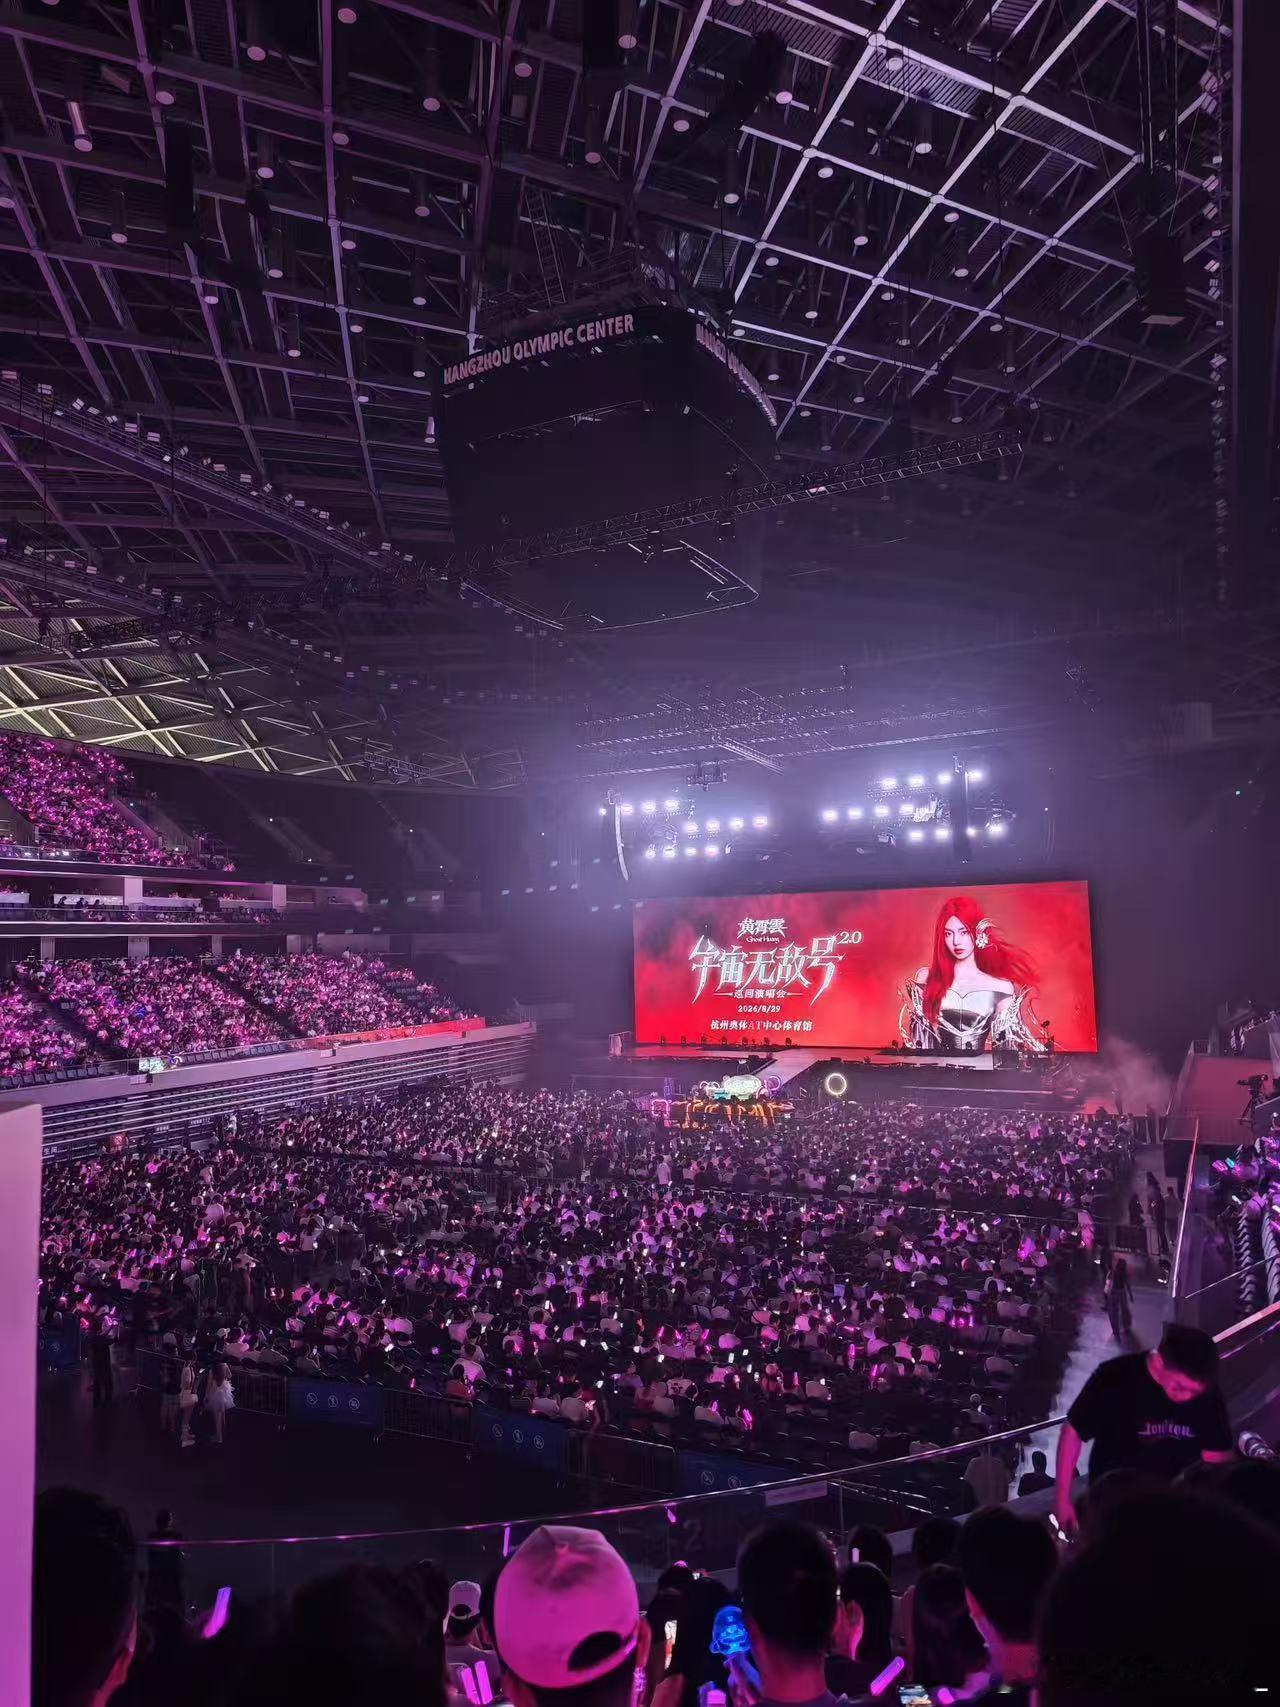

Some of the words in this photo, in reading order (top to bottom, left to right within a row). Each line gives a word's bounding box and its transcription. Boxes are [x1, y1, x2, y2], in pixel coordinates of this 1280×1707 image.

[443, 345, 511, 385] HANGZHOU
[513, 327, 574, 361] OLYMPIC
[576, 313, 634, 344] CENTER
[688, 934, 846, 1007] 宇宙无敌号
[837, 930, 862, 945] 2.0
[734, 988, 787, 999] 巡回演唱会
[737, 1004, 781, 1014] 2026/8/29
